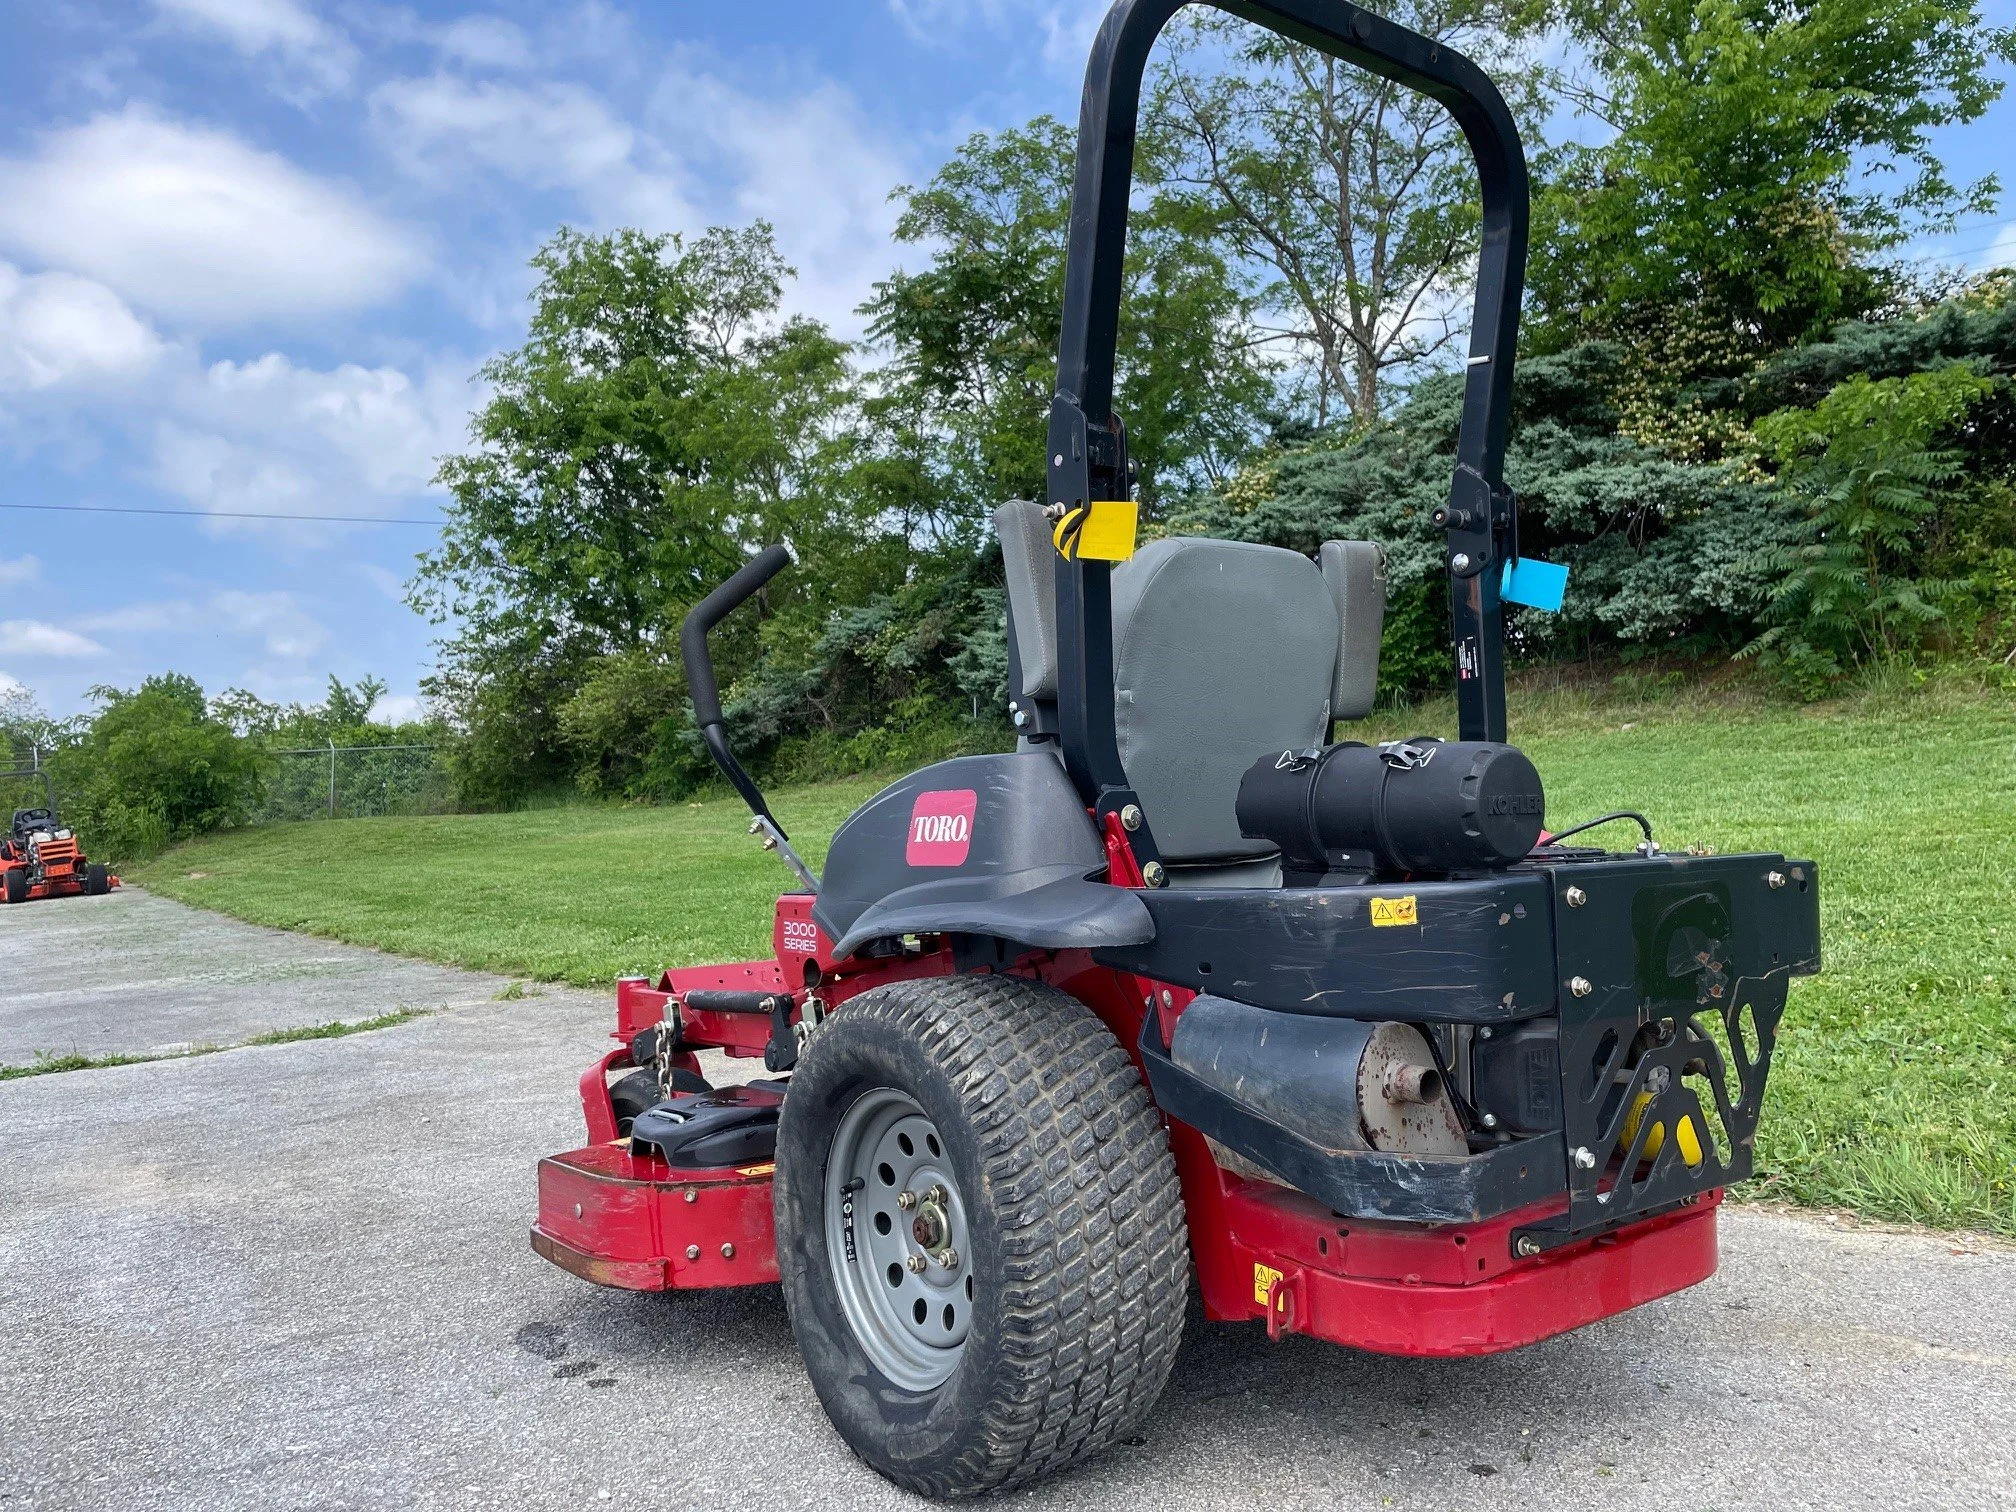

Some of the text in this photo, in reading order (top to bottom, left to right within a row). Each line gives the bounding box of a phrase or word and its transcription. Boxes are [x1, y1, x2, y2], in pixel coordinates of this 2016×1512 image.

[1487, 795, 1543, 815] KOHLER
[913, 814, 967, 842] TORO
[783, 921, 817, 938] 3000
[783, 937, 817, 952] SERIES
